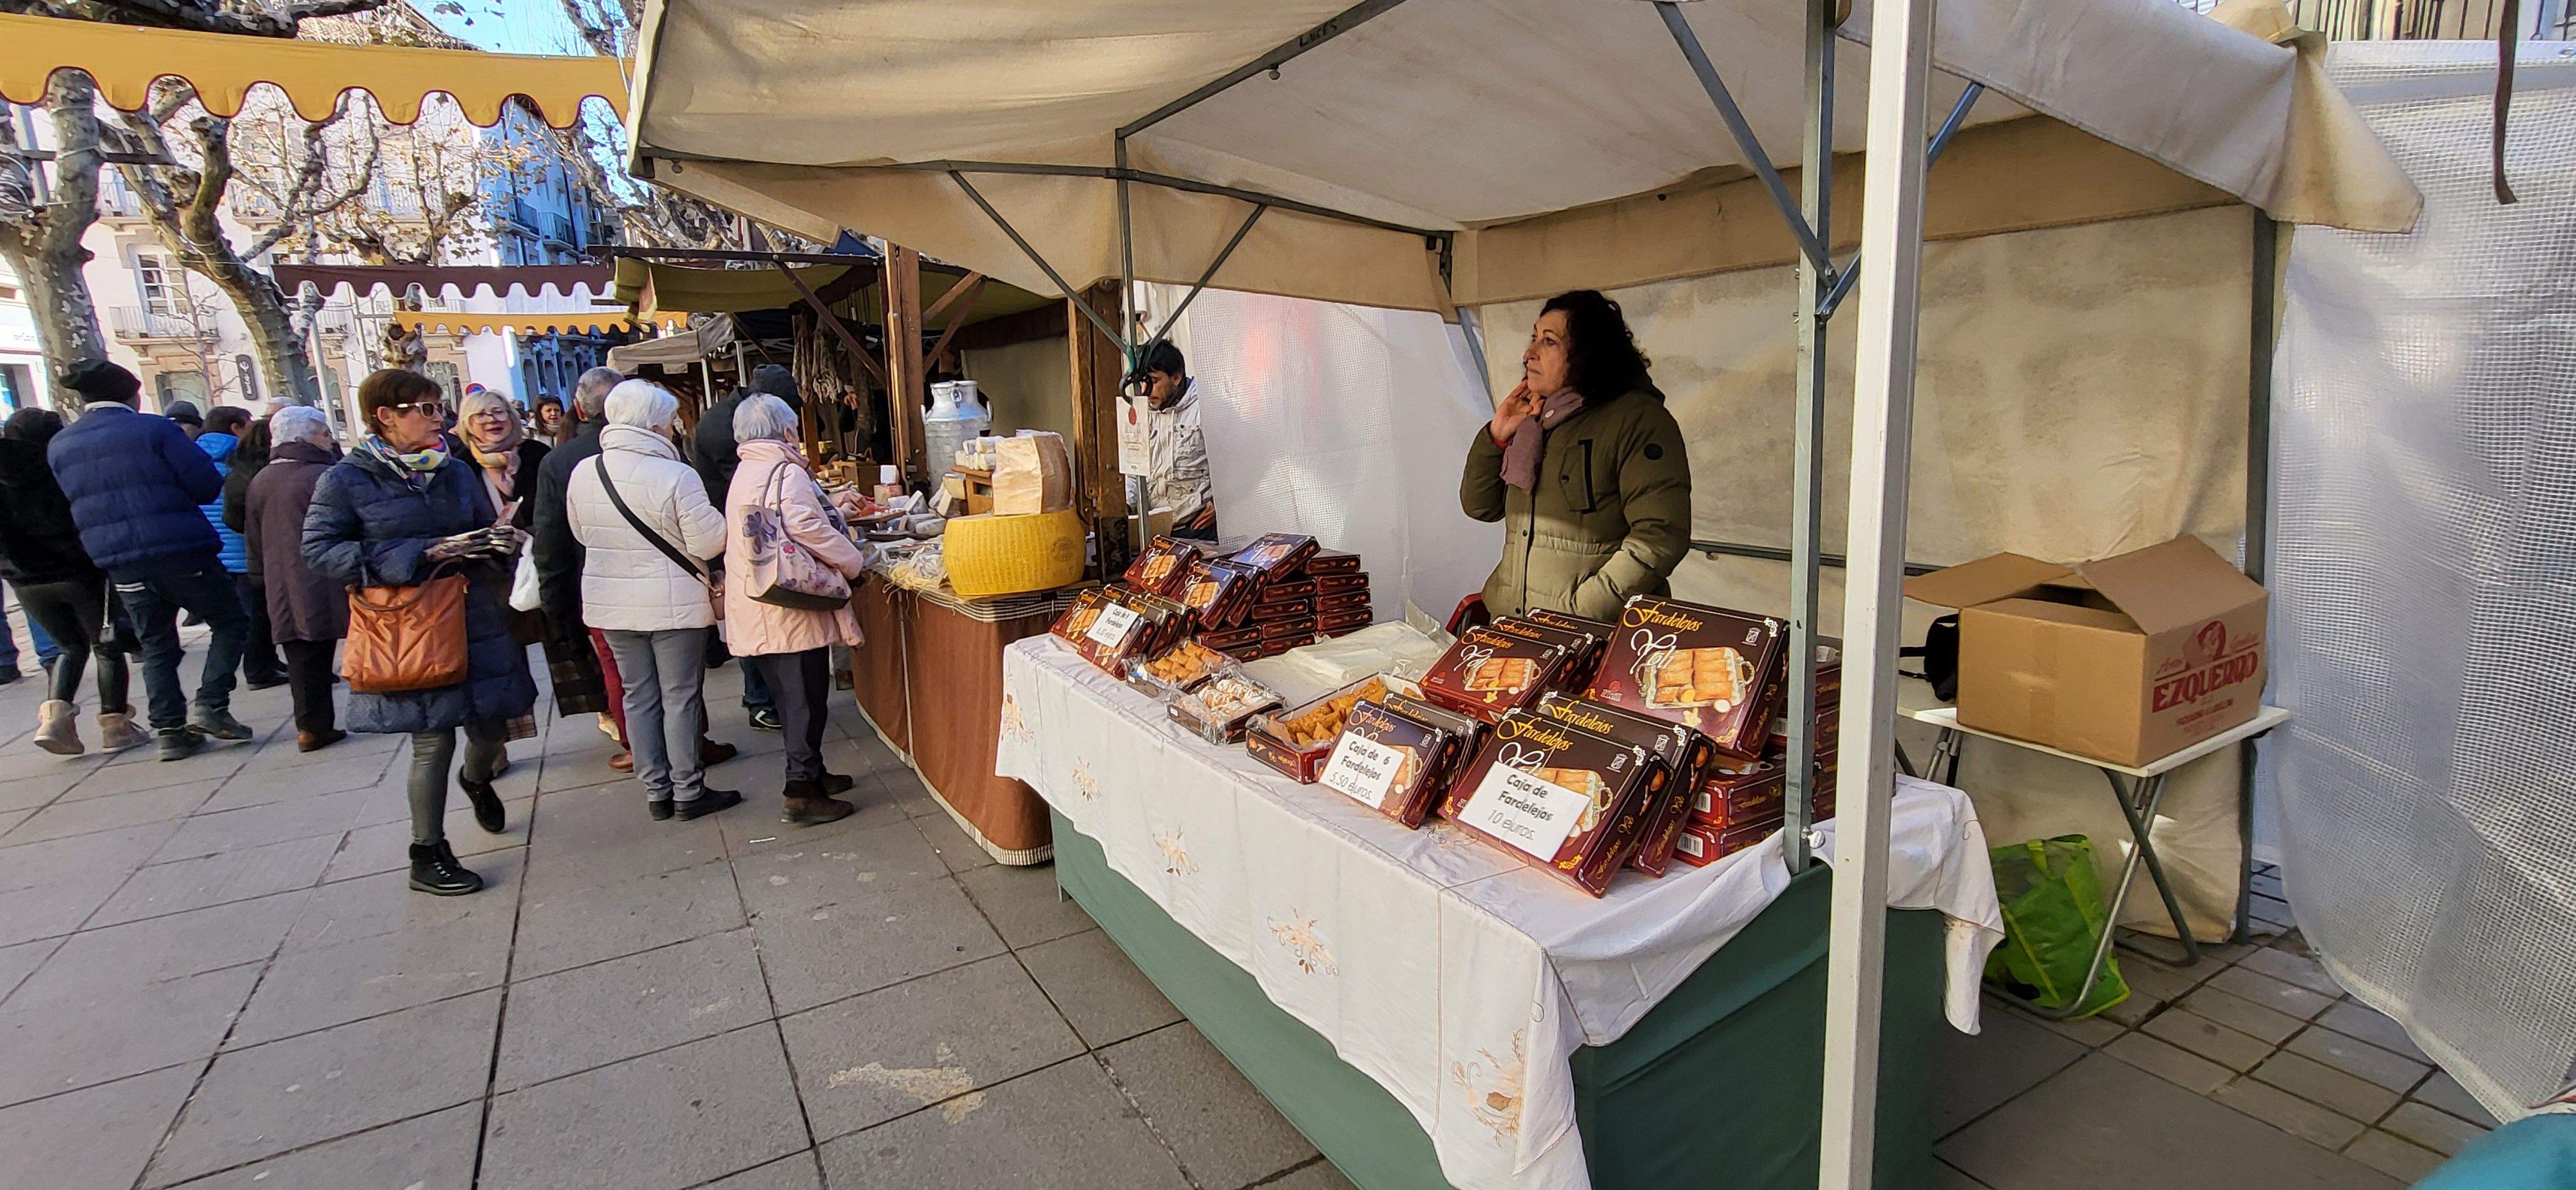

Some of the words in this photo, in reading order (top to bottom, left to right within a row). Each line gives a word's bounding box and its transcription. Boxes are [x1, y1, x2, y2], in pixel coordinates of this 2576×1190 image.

[1624, 601, 1703, 634] Fardelejos
[2152, 651, 2258, 713] EZQUERRO
[1497, 717, 1574, 751] Fardelejos
[1341, 755, 1382, 781] Fardelejos
[1349, 741, 1367, 757] Caja
[1367, 750, 1379, 761] de
[1383, 756, 1391, 765] 6
[1329, 771, 1349, 788] 5.50
[1348, 782, 1372, 800] euros.
[1506, 773, 1531, 793] Caja
[1532, 785, 1549, 798] de
[1498, 790, 1554, 822] Fardelejos
[1488, 809, 1502, 824] 10
[1502, 817, 1536, 841] euros.
